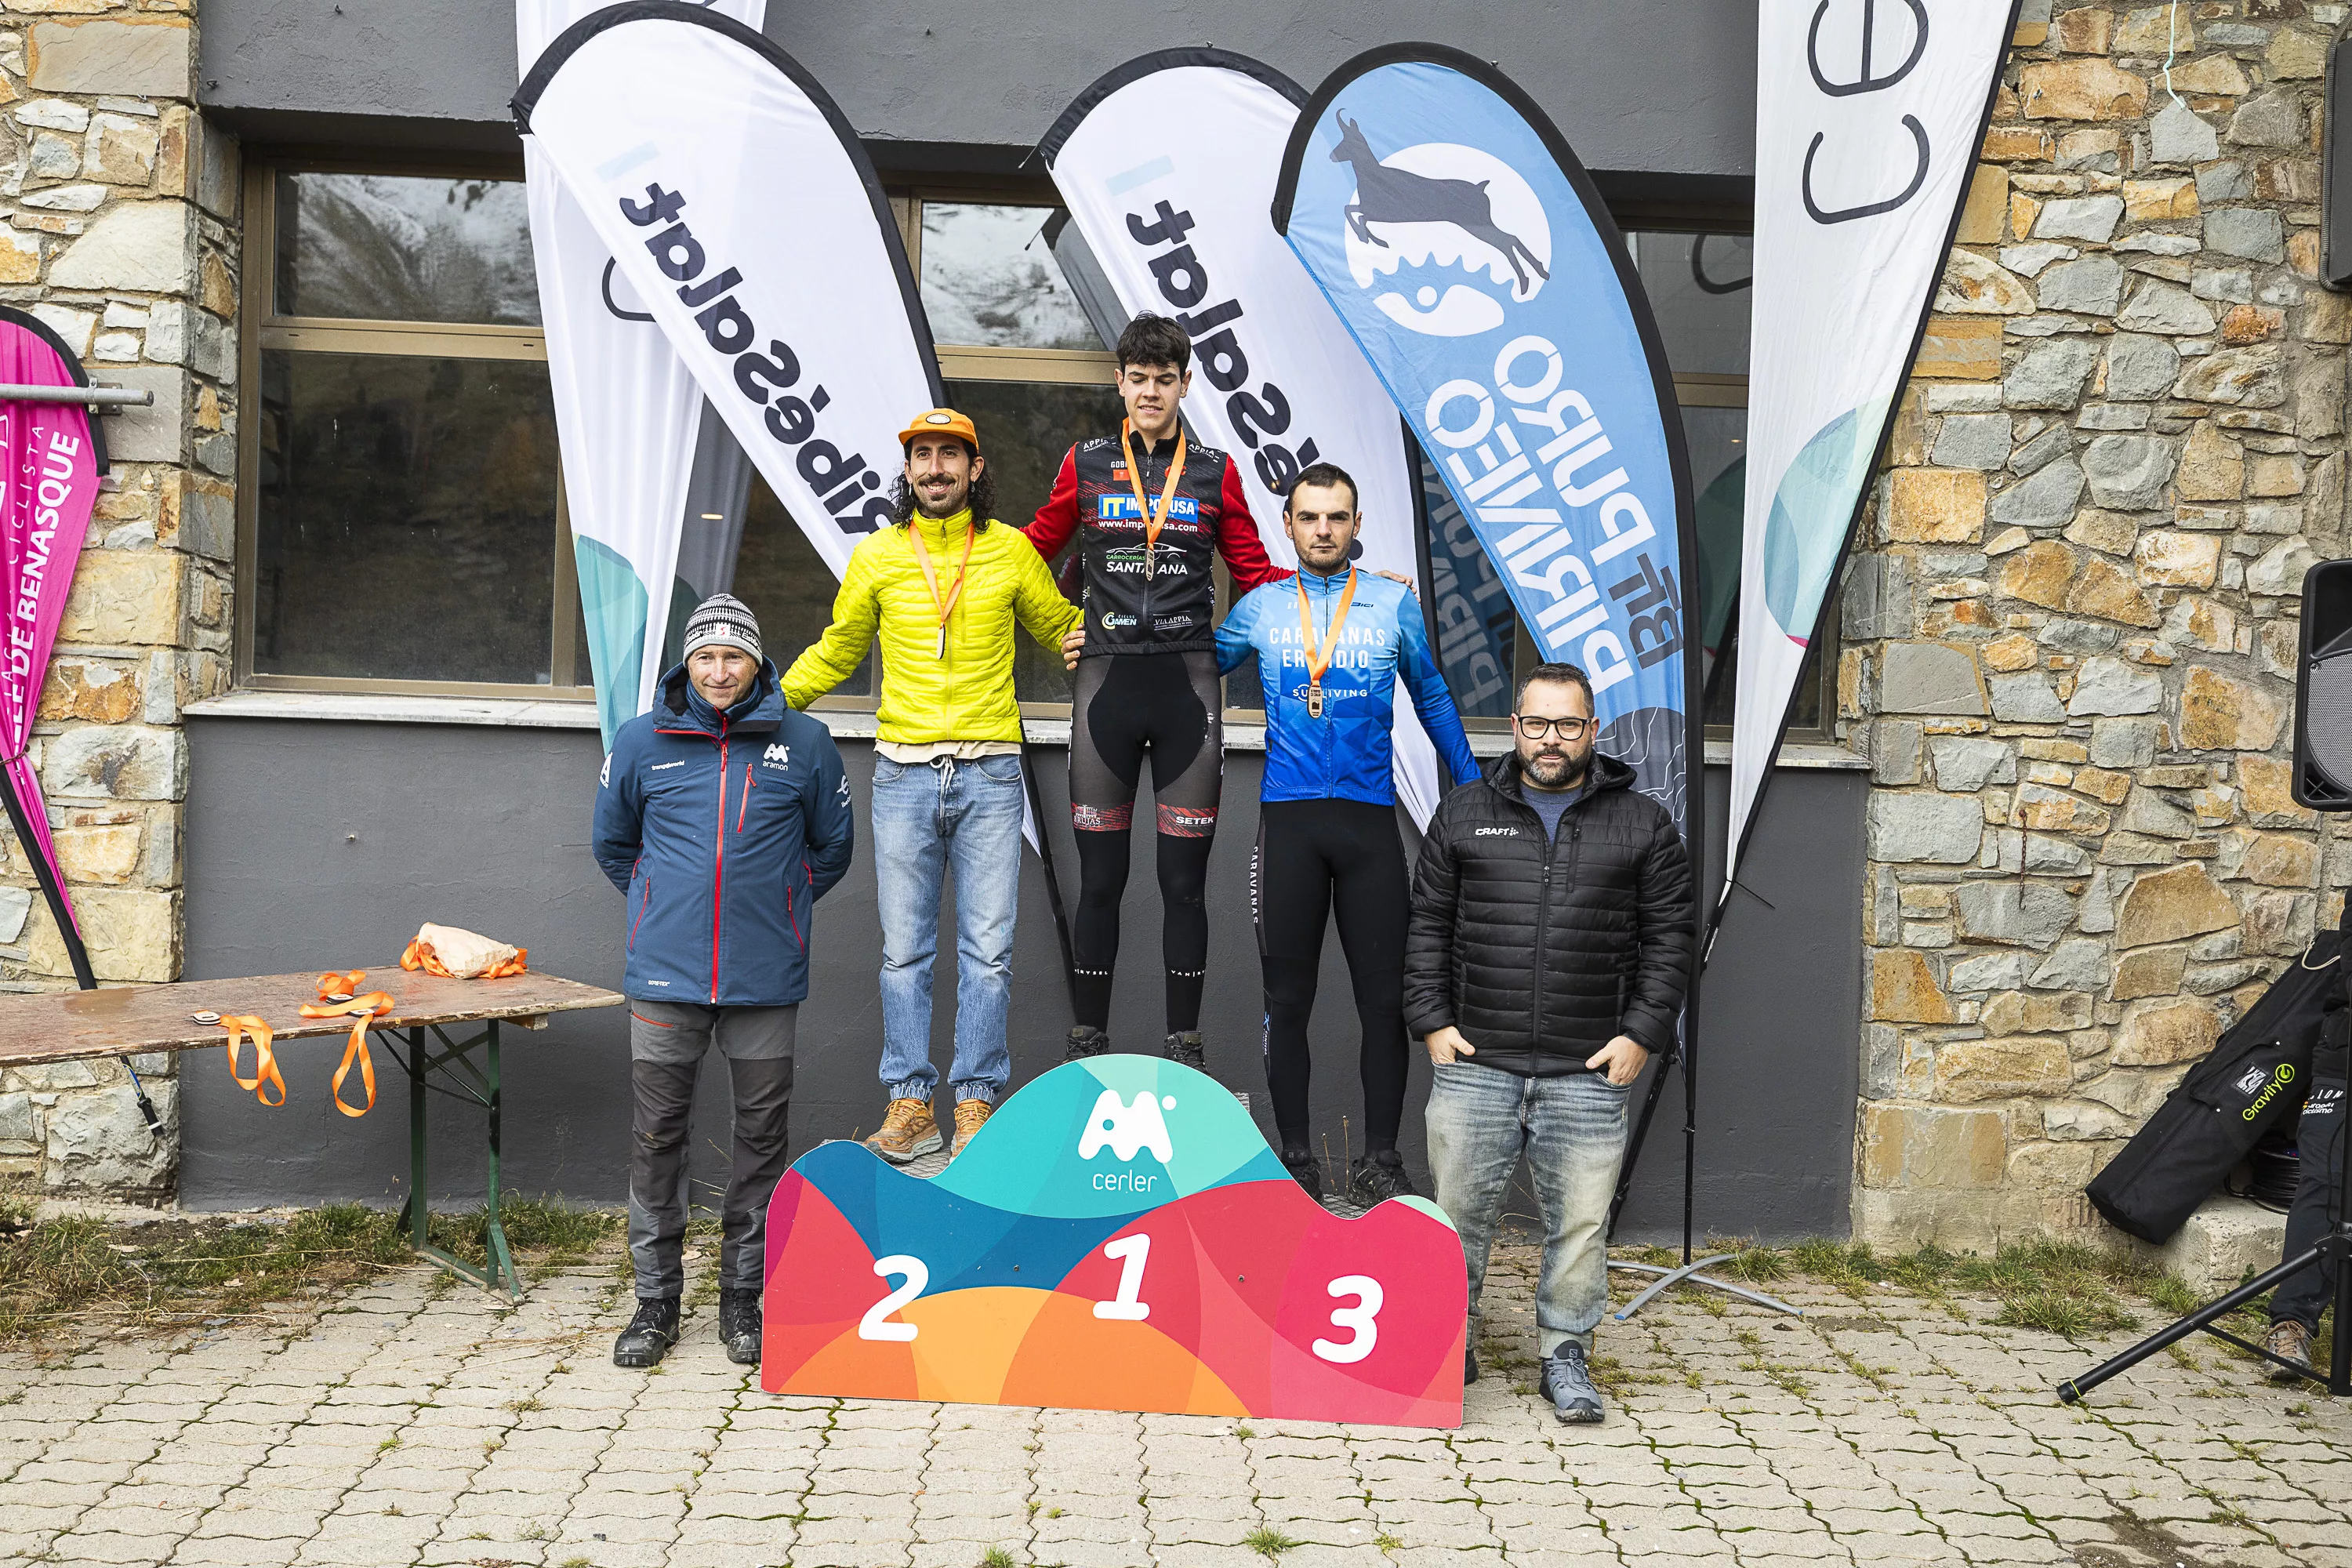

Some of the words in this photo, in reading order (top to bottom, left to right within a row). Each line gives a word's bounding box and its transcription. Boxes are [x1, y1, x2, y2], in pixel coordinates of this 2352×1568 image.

[16, 431, 80, 623] BENASQUE
[1156, 564, 1189, 575] ANA
[1283, 648, 1370, 669] ERDIO
[762, 760, 789, 771] aramon
[1176, 816, 1214, 825] SETEK
[1475, 827, 1510, 836] CRAFT
[1250, 846, 1259, 924] CARAVANAS
[2241, 1079, 2283, 1121] Gravity
[1092, 1169, 1158, 1192] cerler
[858, 1254, 930, 1342] 2
[1093, 1233, 1151, 1320] 1
[1312, 1275, 1385, 1363] 3
